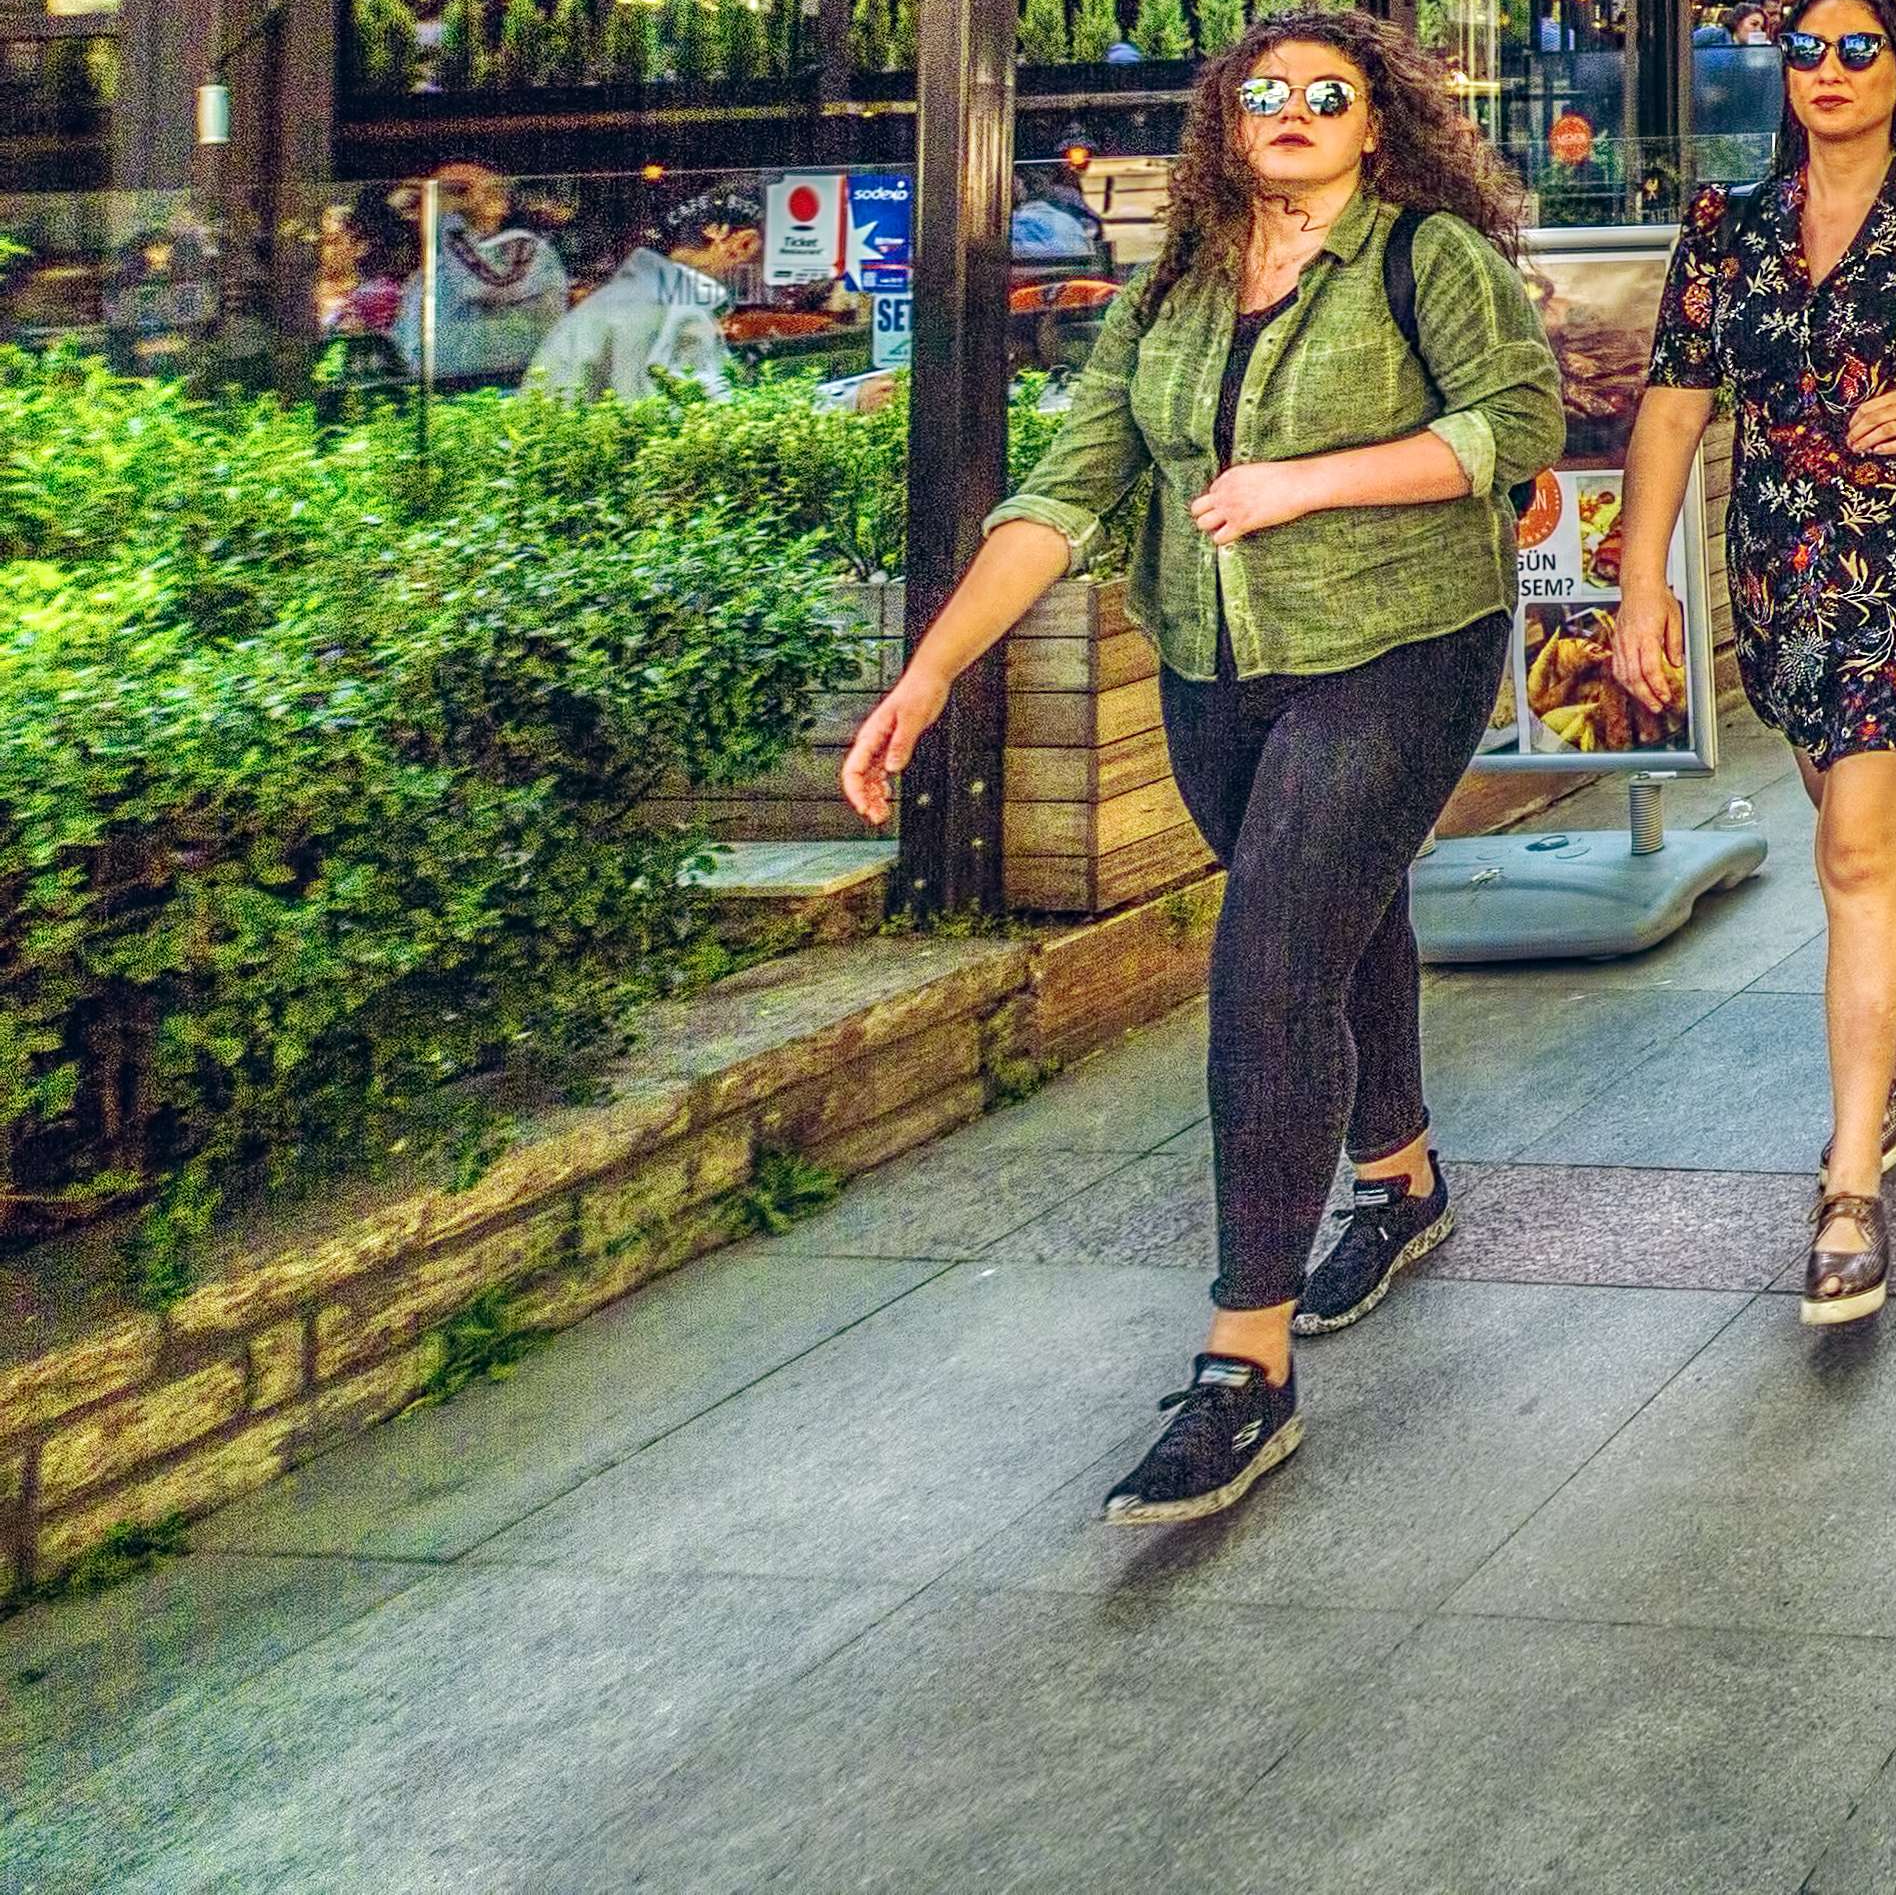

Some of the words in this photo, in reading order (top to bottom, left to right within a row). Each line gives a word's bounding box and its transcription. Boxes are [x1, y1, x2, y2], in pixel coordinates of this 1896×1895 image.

[853, 182, 908, 201] sodexo
[784, 235, 818, 248] Ticket
[1520, 577, 1575, 597] SEM?
